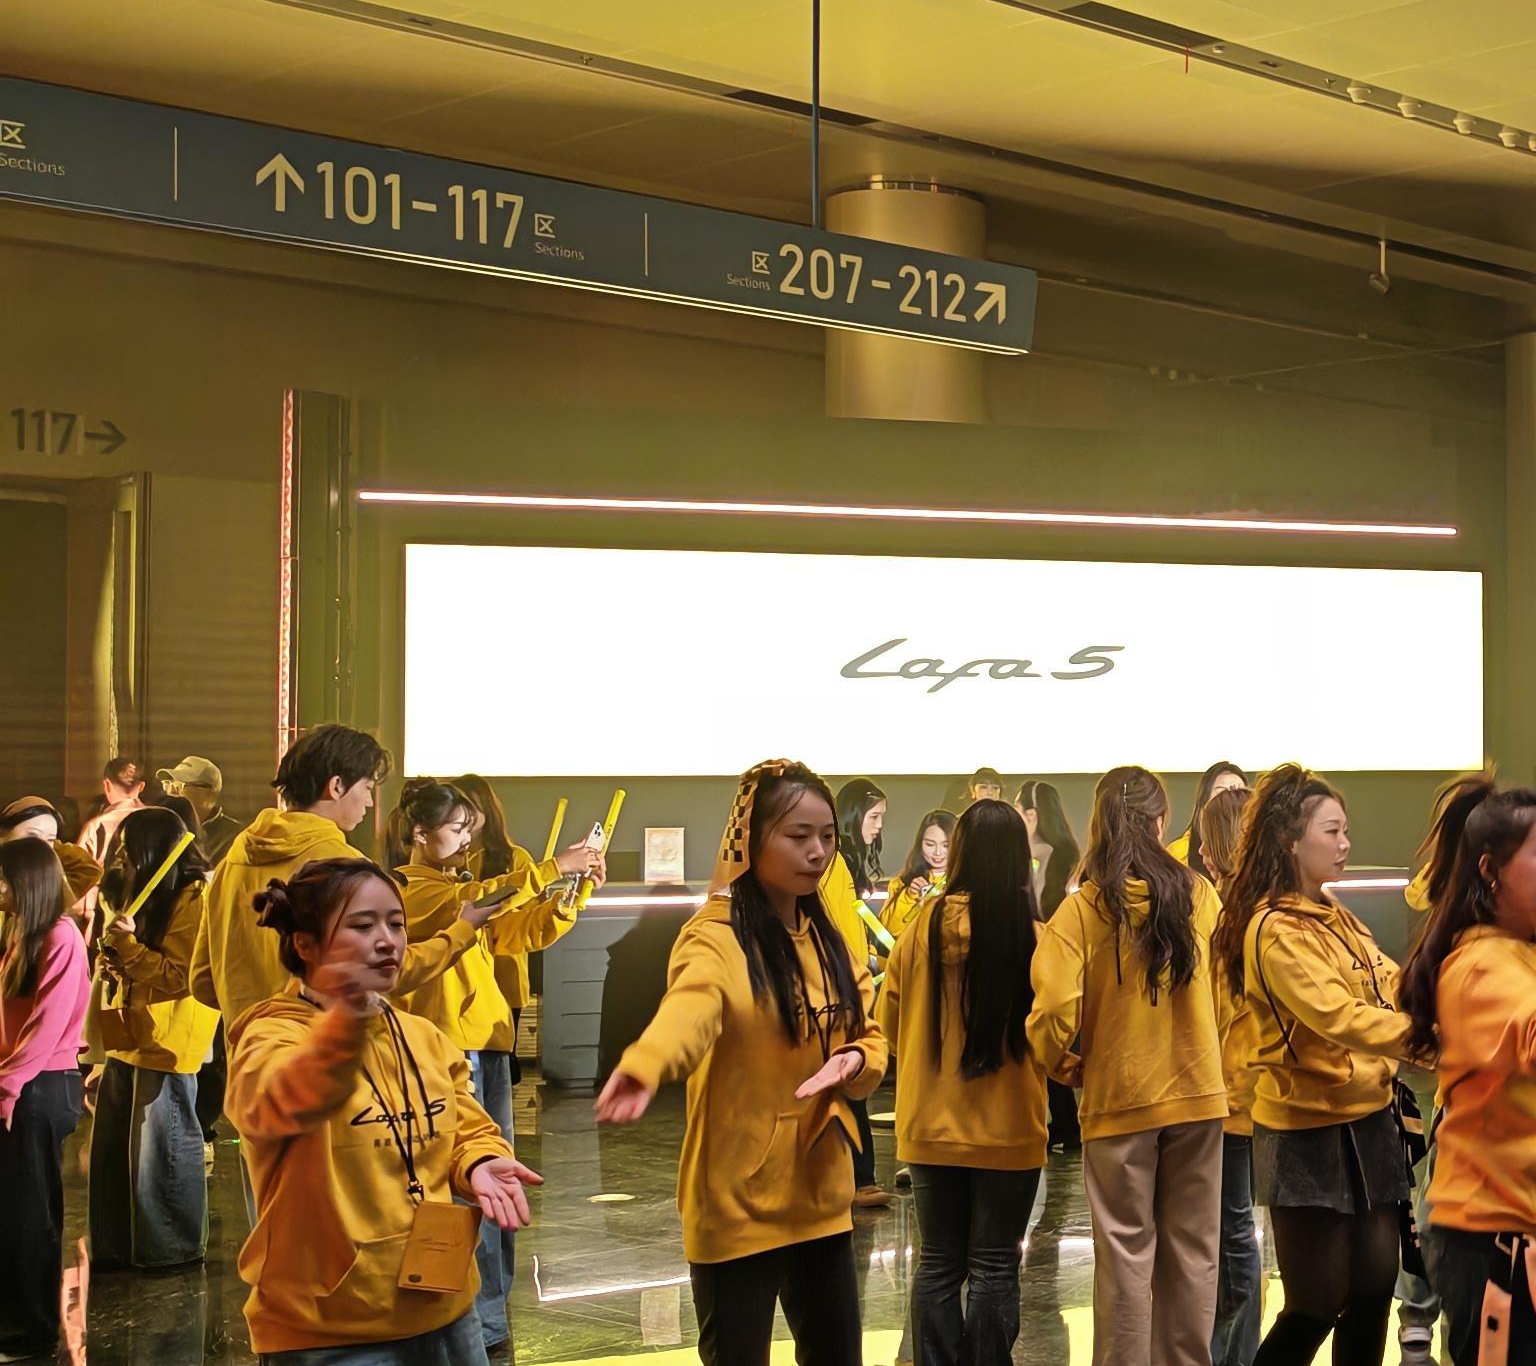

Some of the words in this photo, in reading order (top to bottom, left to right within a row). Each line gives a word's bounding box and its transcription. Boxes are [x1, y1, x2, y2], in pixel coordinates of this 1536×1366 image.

[316, 161, 524, 249] 101-117
[534, 241, 585, 261] Sections
[726, 273, 771, 291] Sections
[779, 243, 967, 323] 207-212
[11, 407, 77, 454] 117
